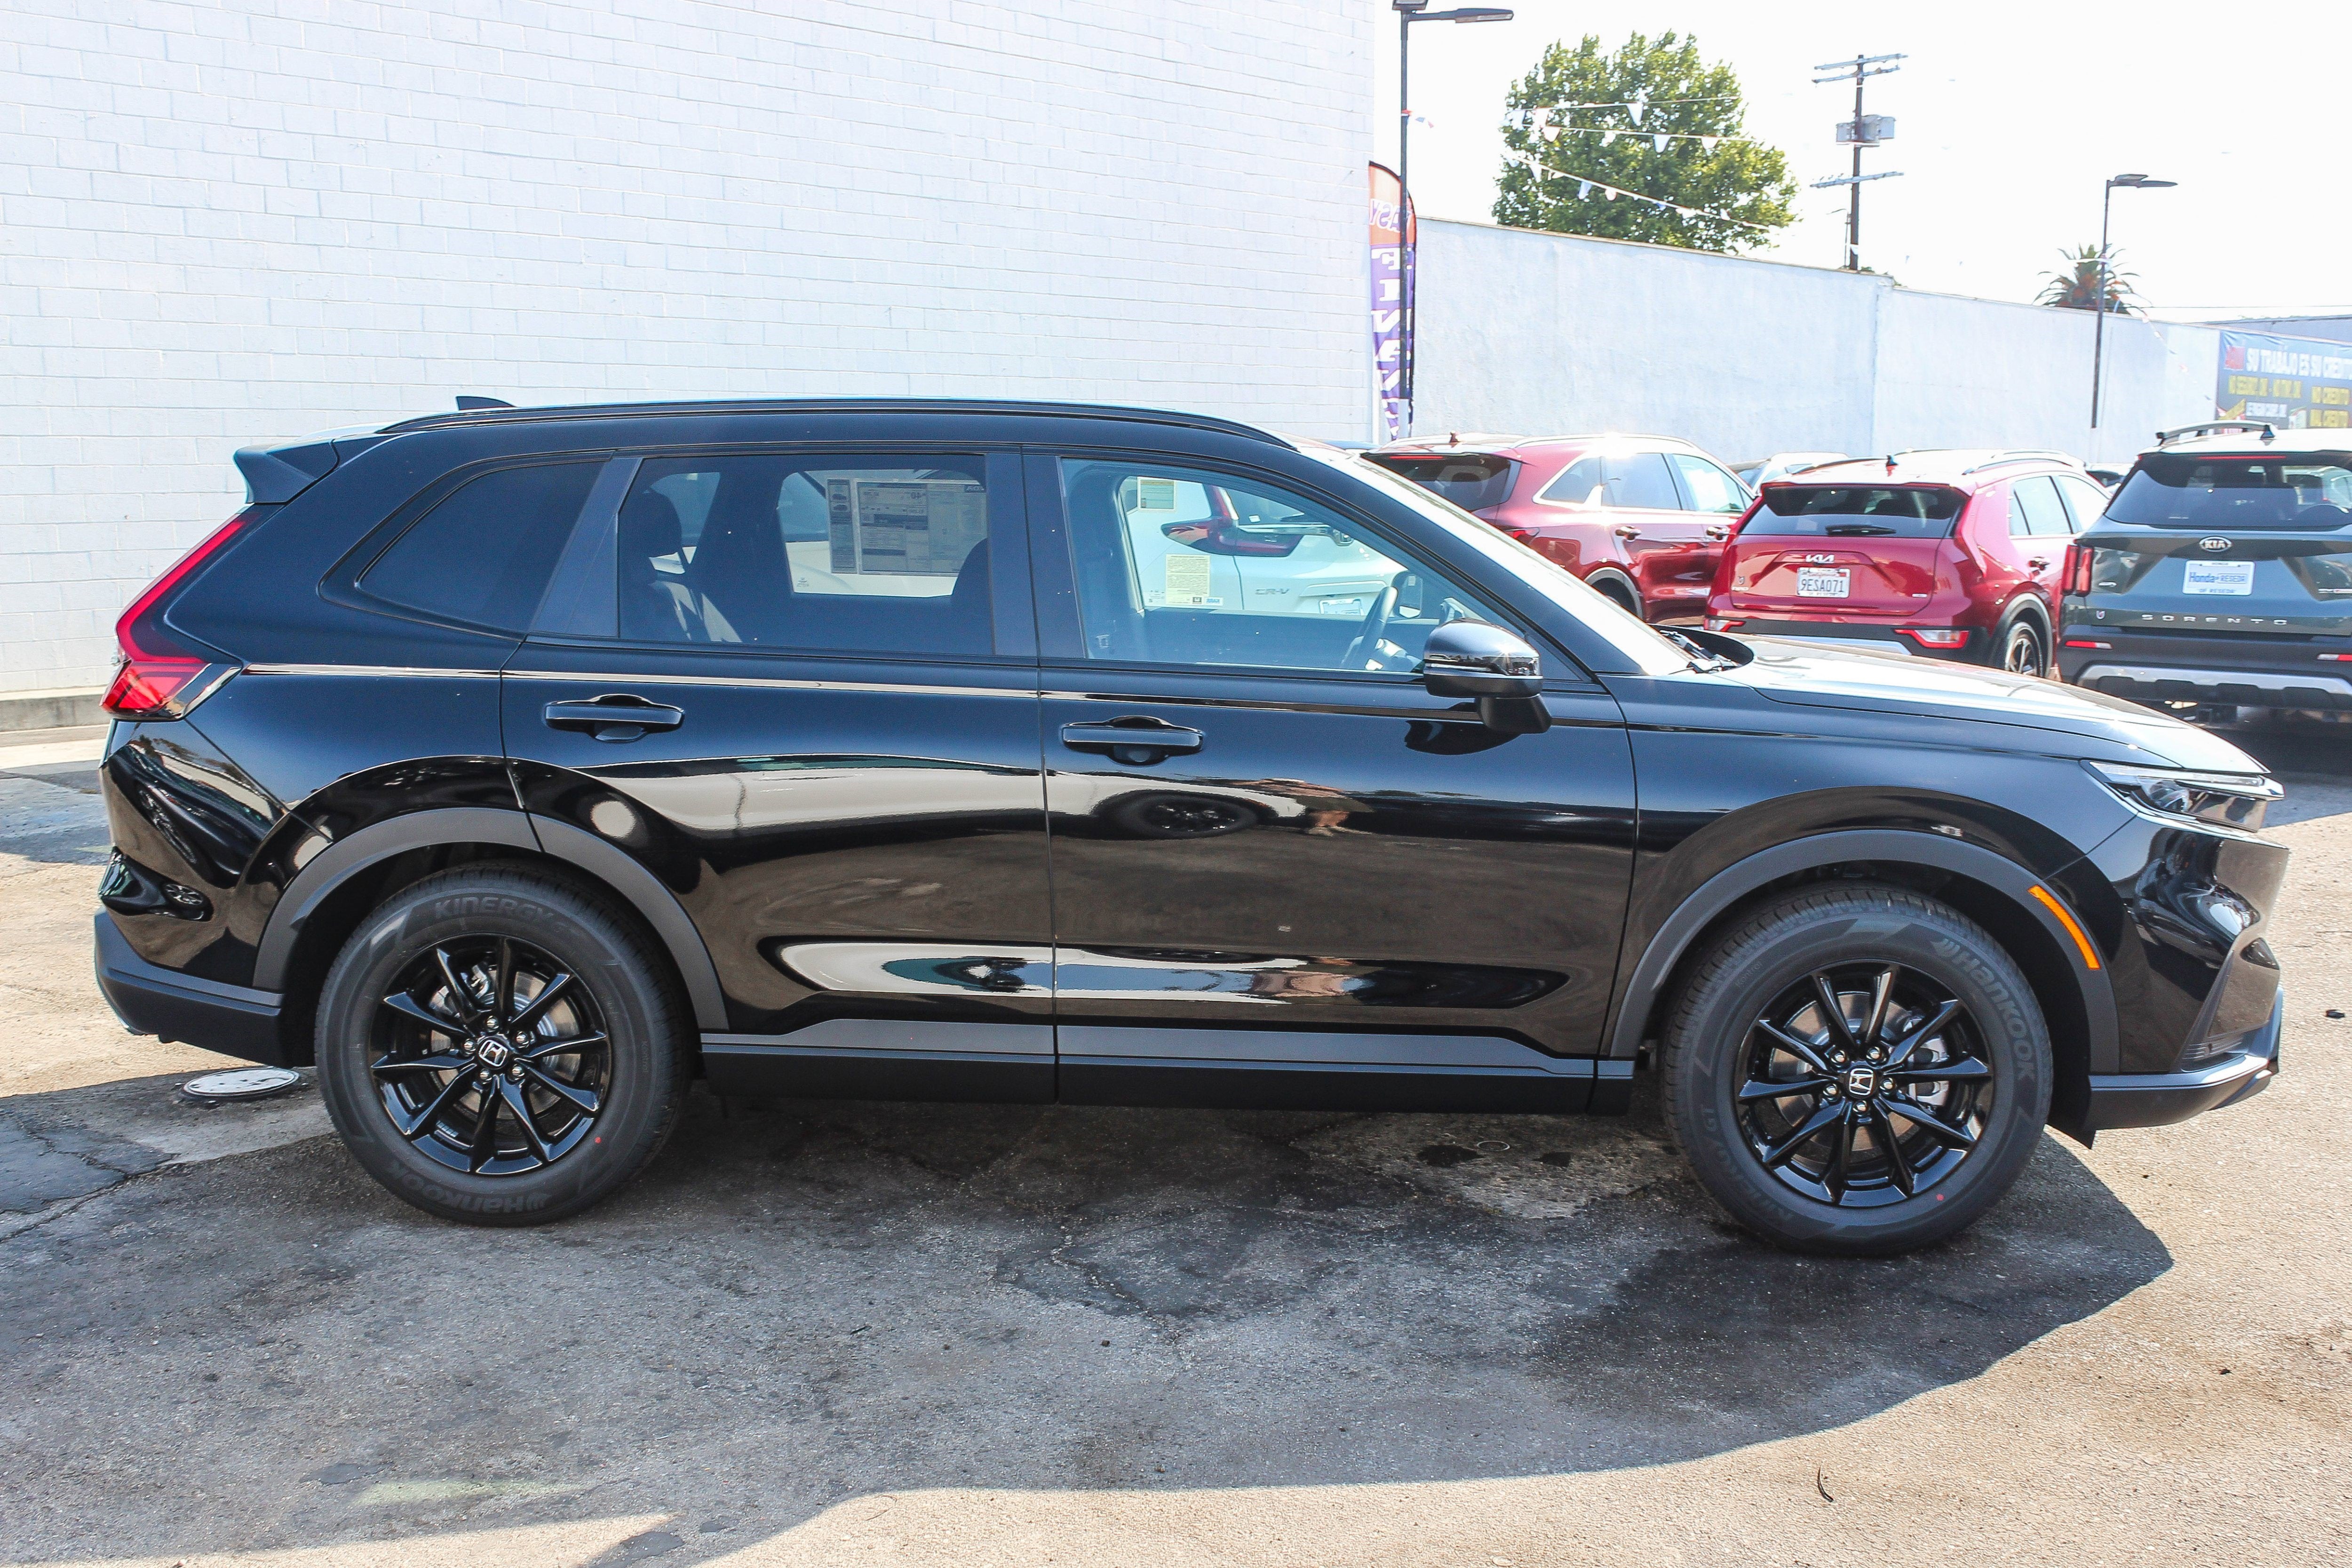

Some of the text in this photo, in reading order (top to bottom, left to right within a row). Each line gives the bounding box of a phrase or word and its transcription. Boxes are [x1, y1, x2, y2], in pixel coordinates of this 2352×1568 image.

[2204, 540, 2226, 549] KIA
[1801, 578, 1844, 593] 9ESA071
[2141, 613, 2288, 626] SORENTO
